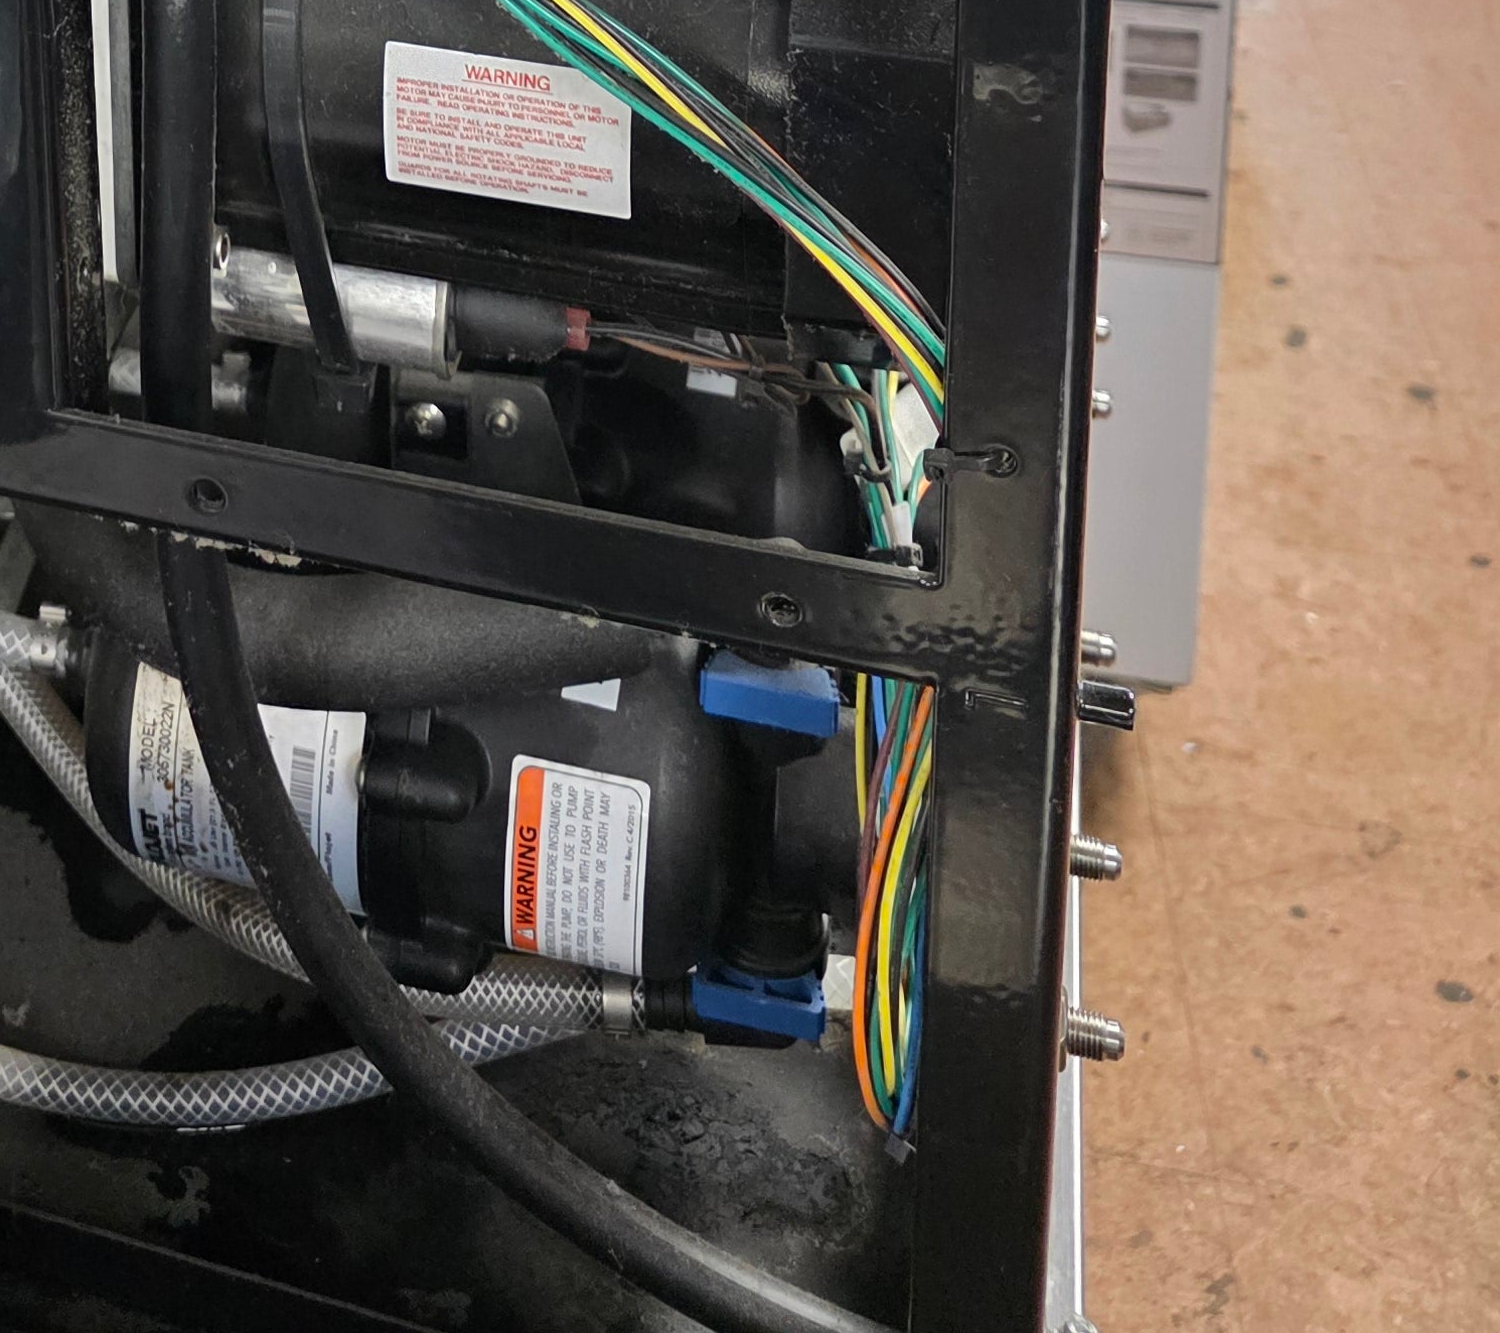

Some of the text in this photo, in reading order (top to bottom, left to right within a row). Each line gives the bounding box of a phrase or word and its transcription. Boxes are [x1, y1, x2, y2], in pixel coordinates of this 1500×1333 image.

[464, 63, 551, 91] WARNING
[139, 717, 157, 770] MODEL
[551, 781, 563, 799] OR
[582, 788, 594, 821] POINT
[600, 791, 611, 816] MAY
[562, 785, 578, 903] DO NOT USE TO PUMP
[580, 824, 592, 856] FLASH
[596, 821, 609, 855] DEATH
[515, 824, 538, 925] WARNING
[579, 859, 590, 883] WITH
[595, 859, 607, 874] OR
